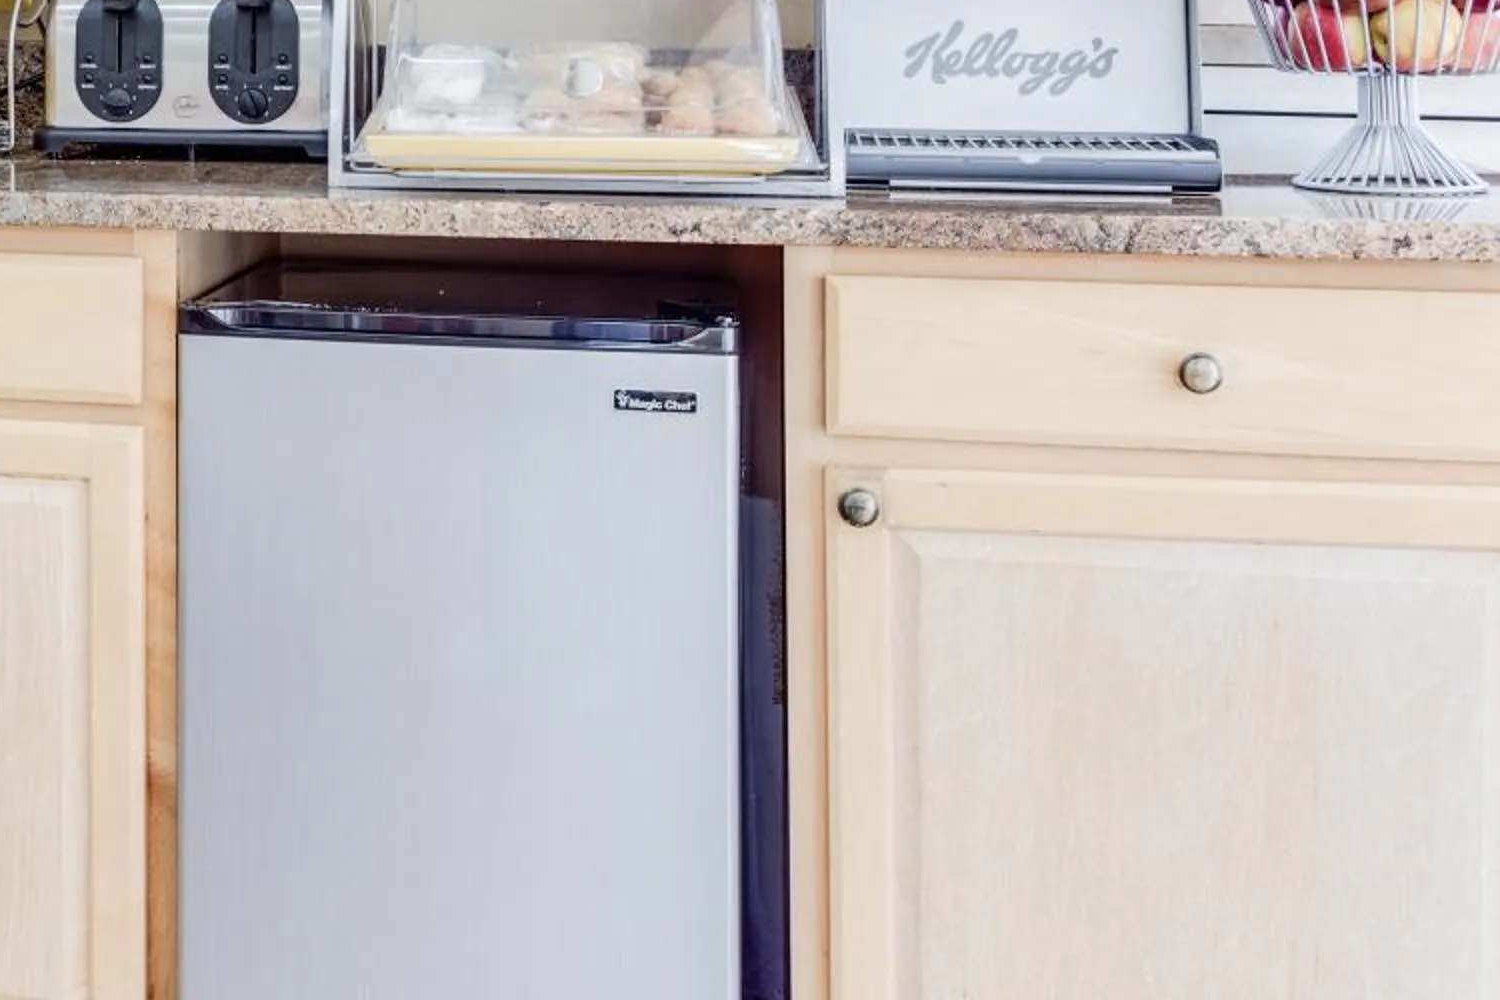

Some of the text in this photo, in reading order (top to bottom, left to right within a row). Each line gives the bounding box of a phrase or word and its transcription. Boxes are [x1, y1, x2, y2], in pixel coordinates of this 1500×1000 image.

[902, 19, 1119, 96] Kellogg's
[629, 398, 692, 411] Magic Chef
